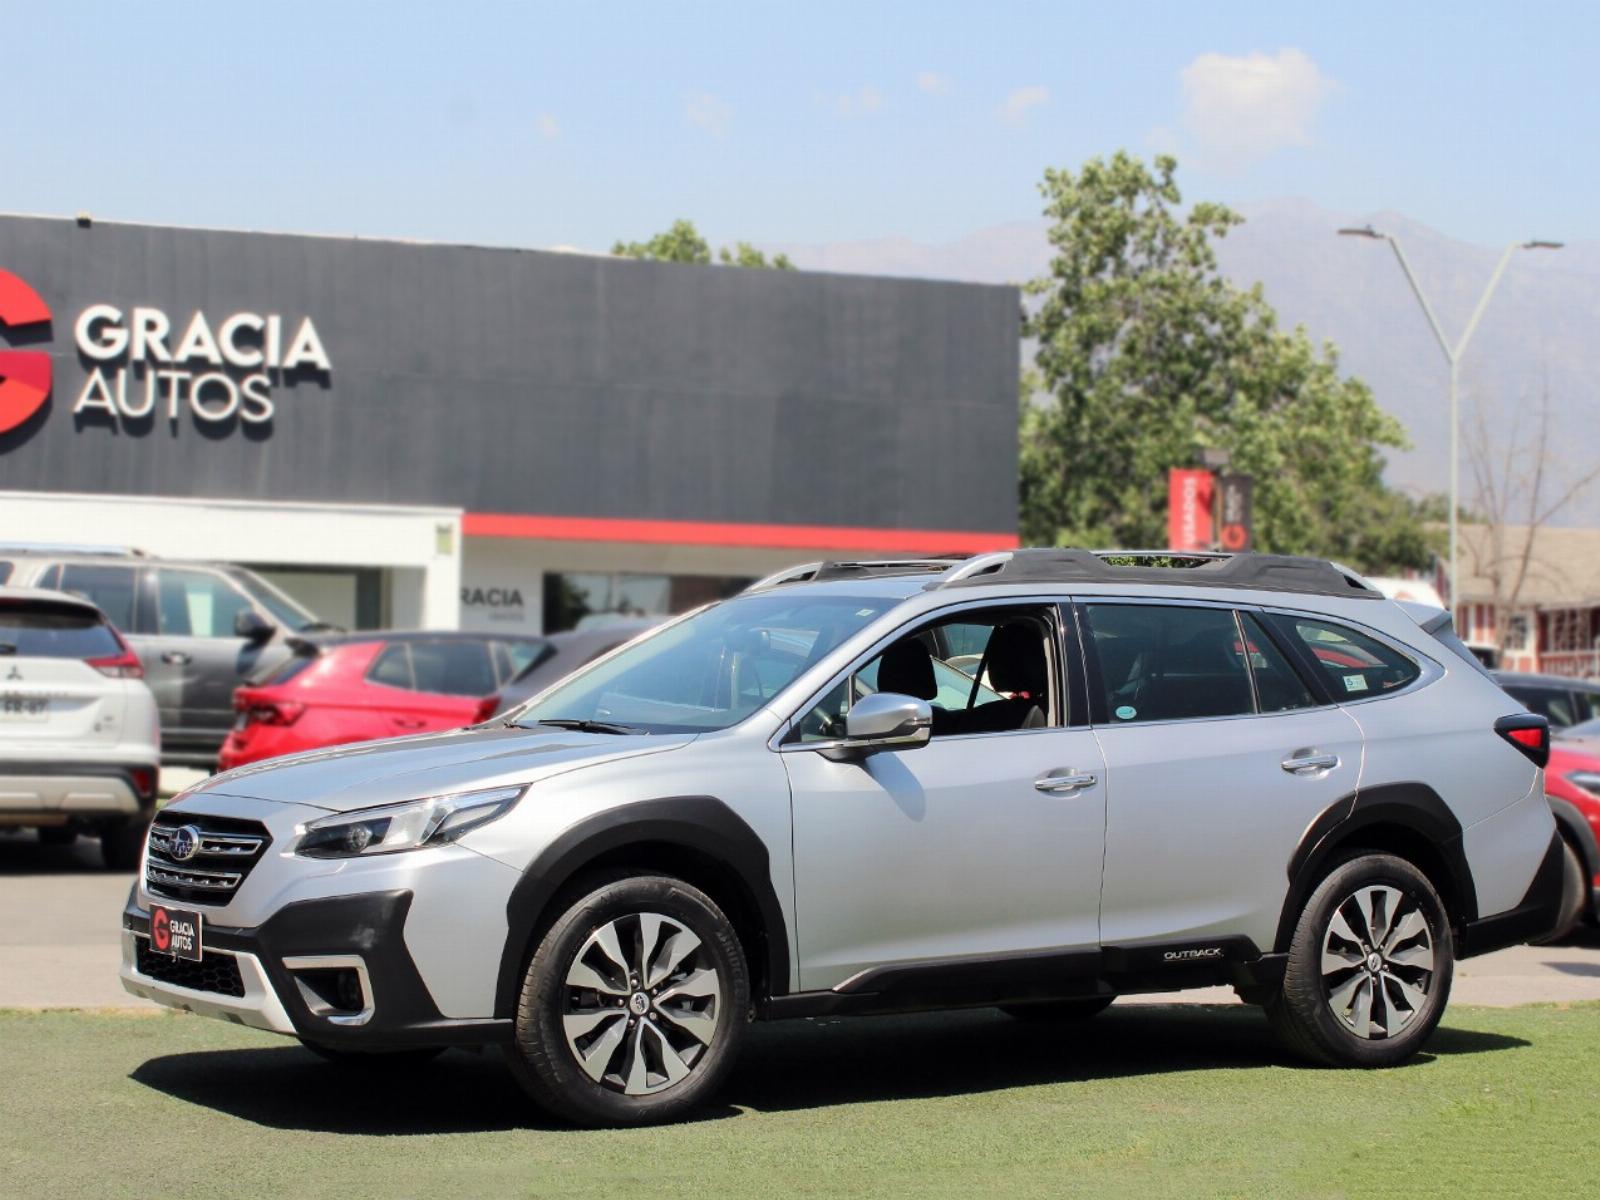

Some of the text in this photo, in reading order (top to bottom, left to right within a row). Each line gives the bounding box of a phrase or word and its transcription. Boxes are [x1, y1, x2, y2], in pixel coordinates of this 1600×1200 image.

[75, 304, 331, 370] GRACIA
[73, 367, 275, 422] AUTOS
[460, 587, 524, 607] RACIA
[170, 920, 195, 937] GRACIA
[171, 934, 193, 951] AUTOS
[1164, 947, 1221, 960] OUTBACK
